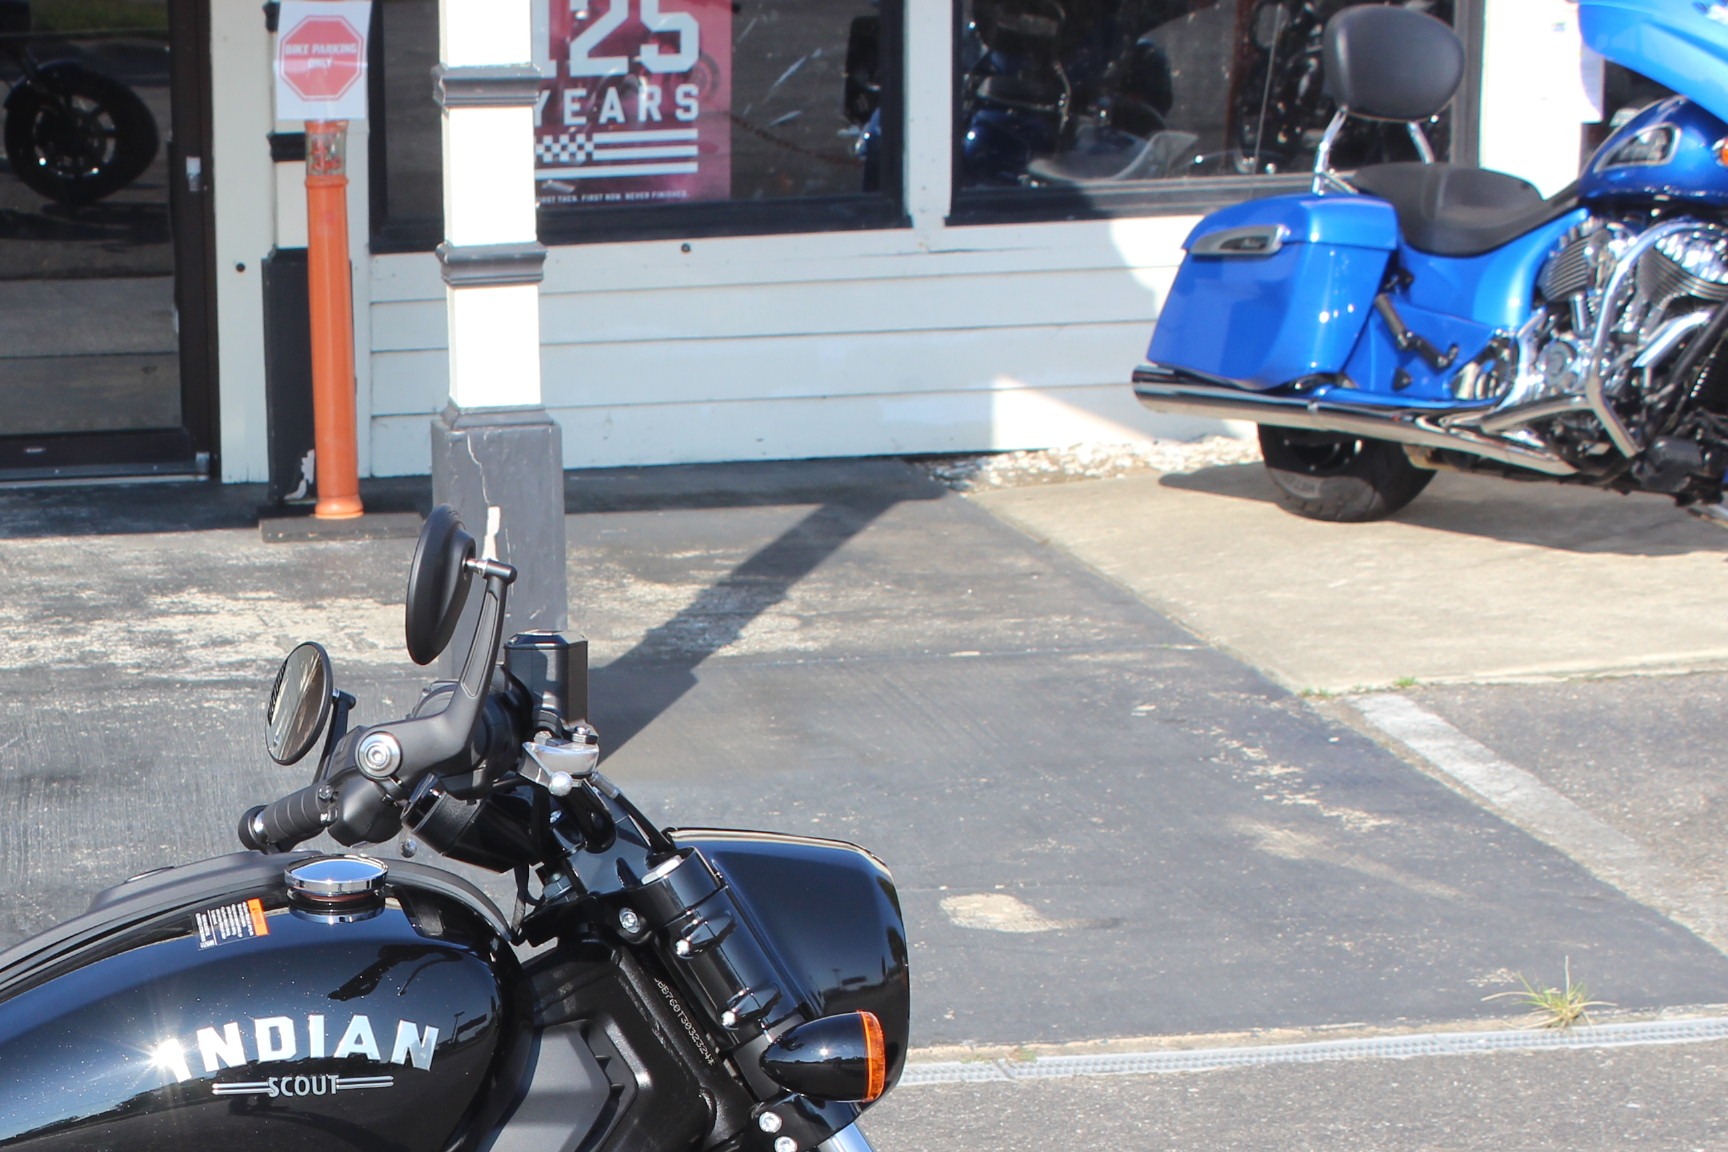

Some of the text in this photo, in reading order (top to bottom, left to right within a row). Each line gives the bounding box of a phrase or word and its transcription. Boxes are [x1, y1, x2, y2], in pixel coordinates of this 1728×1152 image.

[312, 43, 358, 55] PARKING
[158, 1014, 440, 1083] INDIAN
[268, 1073, 340, 1099] SCOUT
